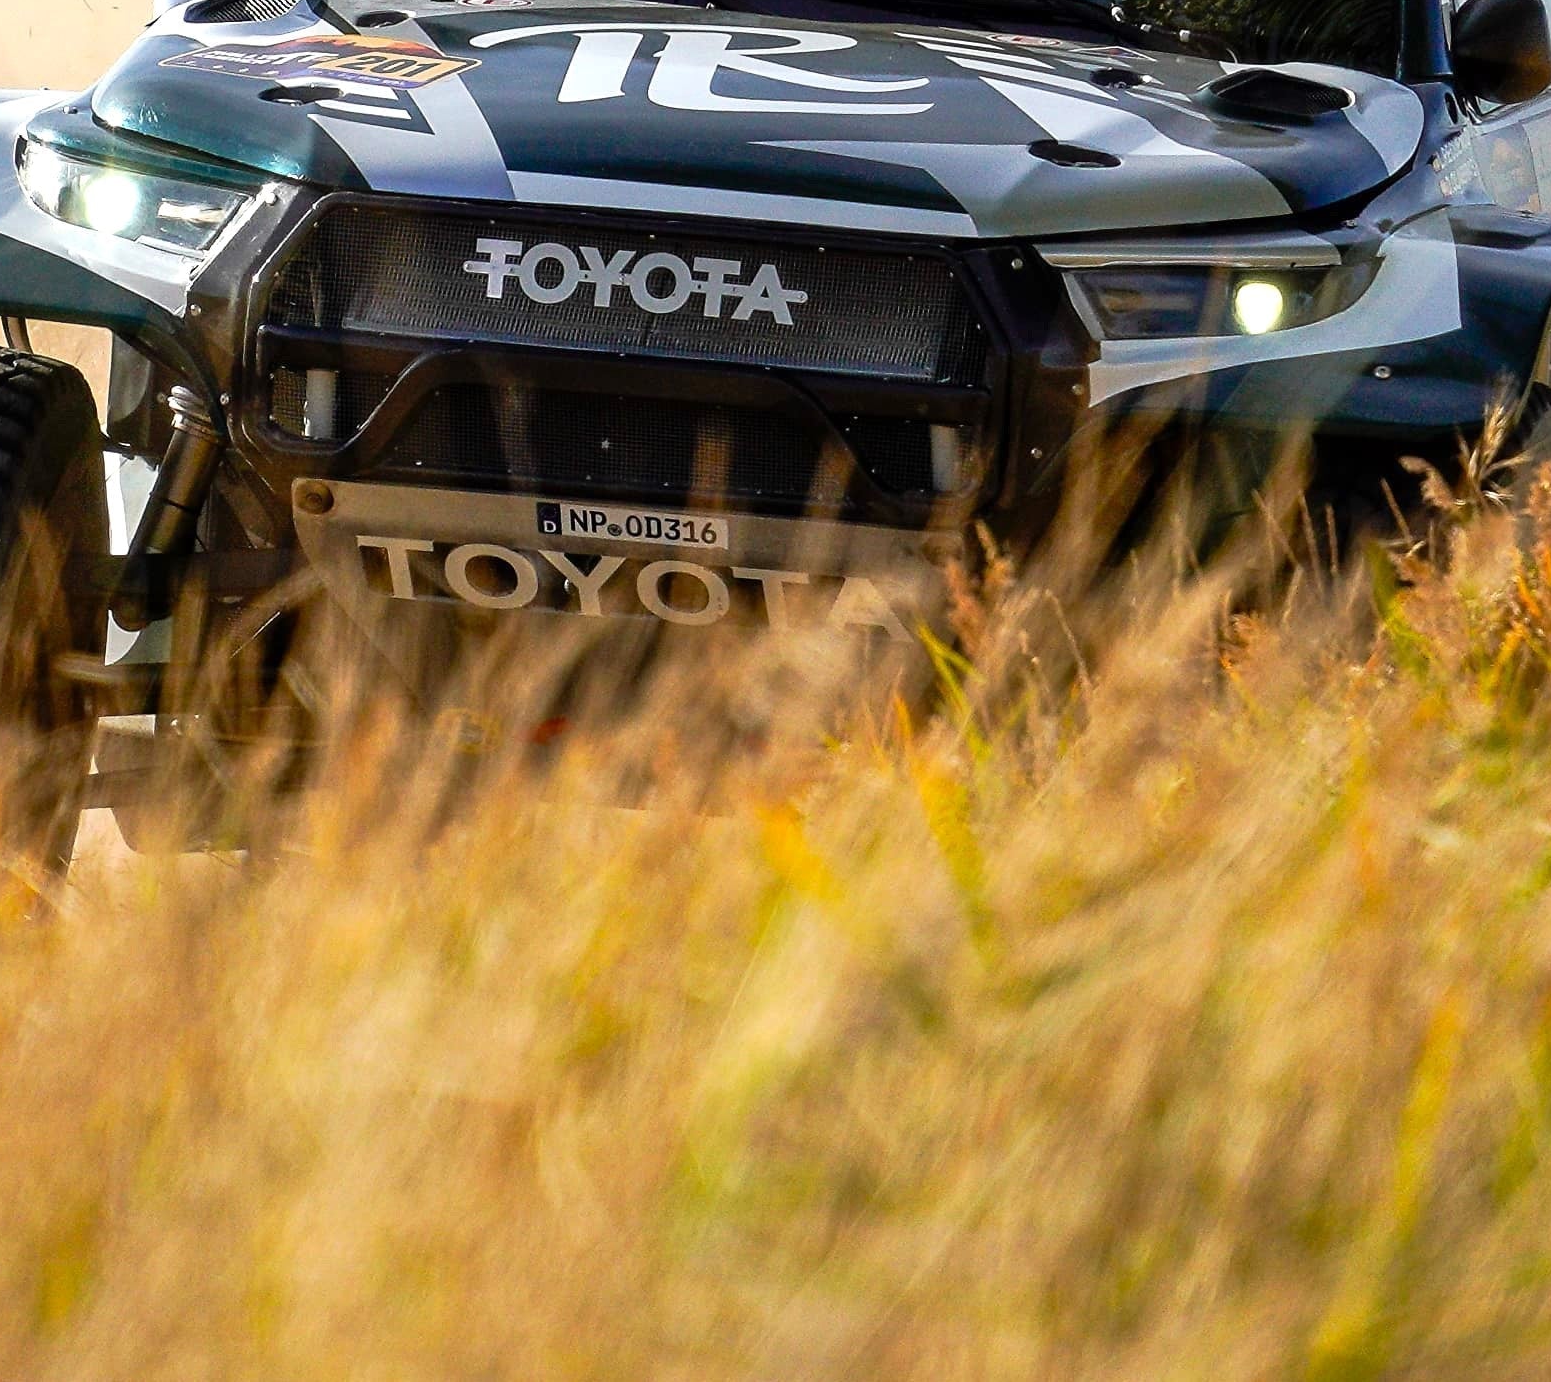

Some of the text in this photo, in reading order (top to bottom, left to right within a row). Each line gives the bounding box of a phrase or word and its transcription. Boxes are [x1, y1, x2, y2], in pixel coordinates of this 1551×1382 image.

[337, 56, 438, 77] 201
[477, 238, 793, 325] TOYOTA
[543, 520, 557, 533] D
[356, 535, 915, 643] TOYOTA
